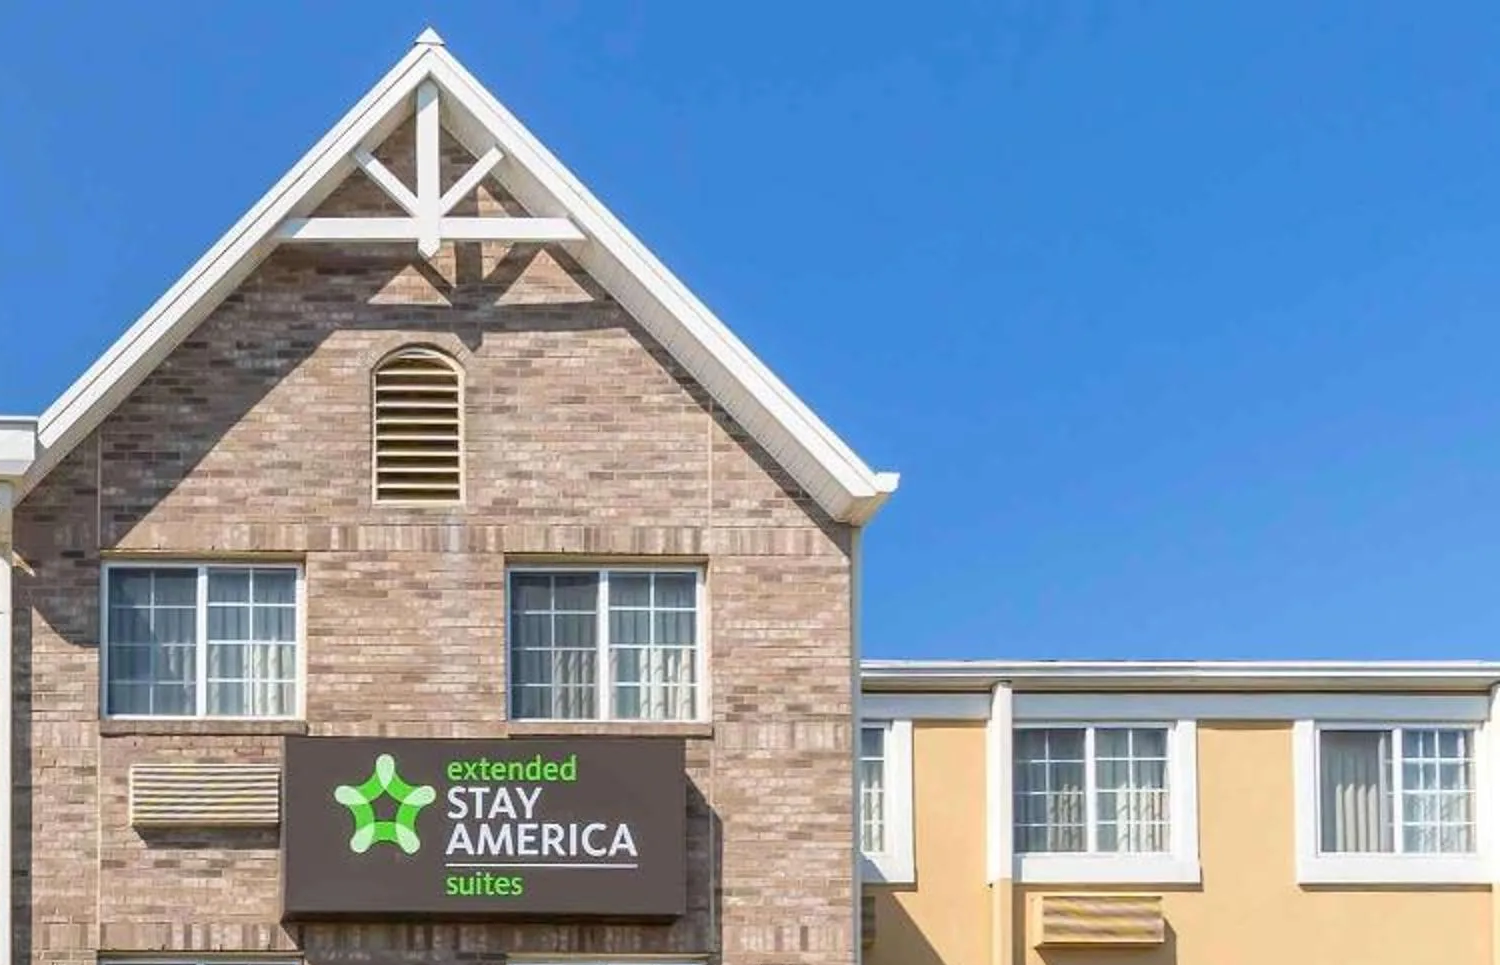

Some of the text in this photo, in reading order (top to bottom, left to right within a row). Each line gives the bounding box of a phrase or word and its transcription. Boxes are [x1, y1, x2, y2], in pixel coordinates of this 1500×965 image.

[446, 754, 577, 782] extended
[446, 786, 543, 820] STAY
[445, 823, 638, 857] AMERICA
[445, 871, 523, 896] suites
